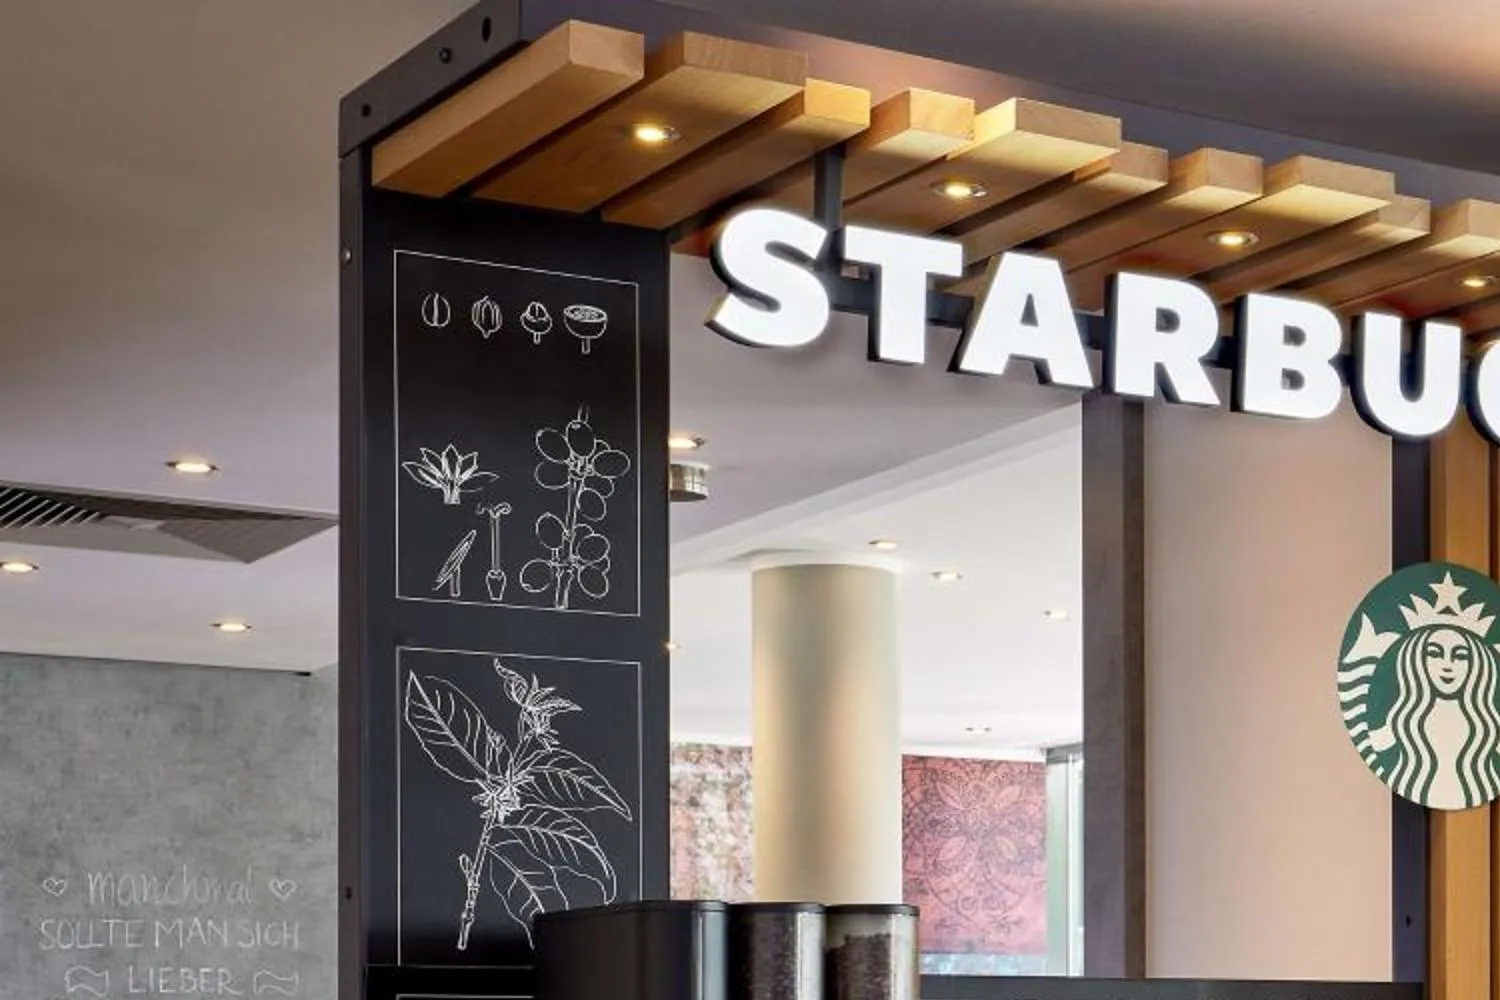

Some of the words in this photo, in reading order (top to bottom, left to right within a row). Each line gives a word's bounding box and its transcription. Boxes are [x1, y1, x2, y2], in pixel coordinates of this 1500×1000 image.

[39, 918, 145, 950] SOLLTE
[155, 917, 228, 948] MAN
[237, 920, 299, 949] SICH
[128, 965, 243, 995] LIEBER
